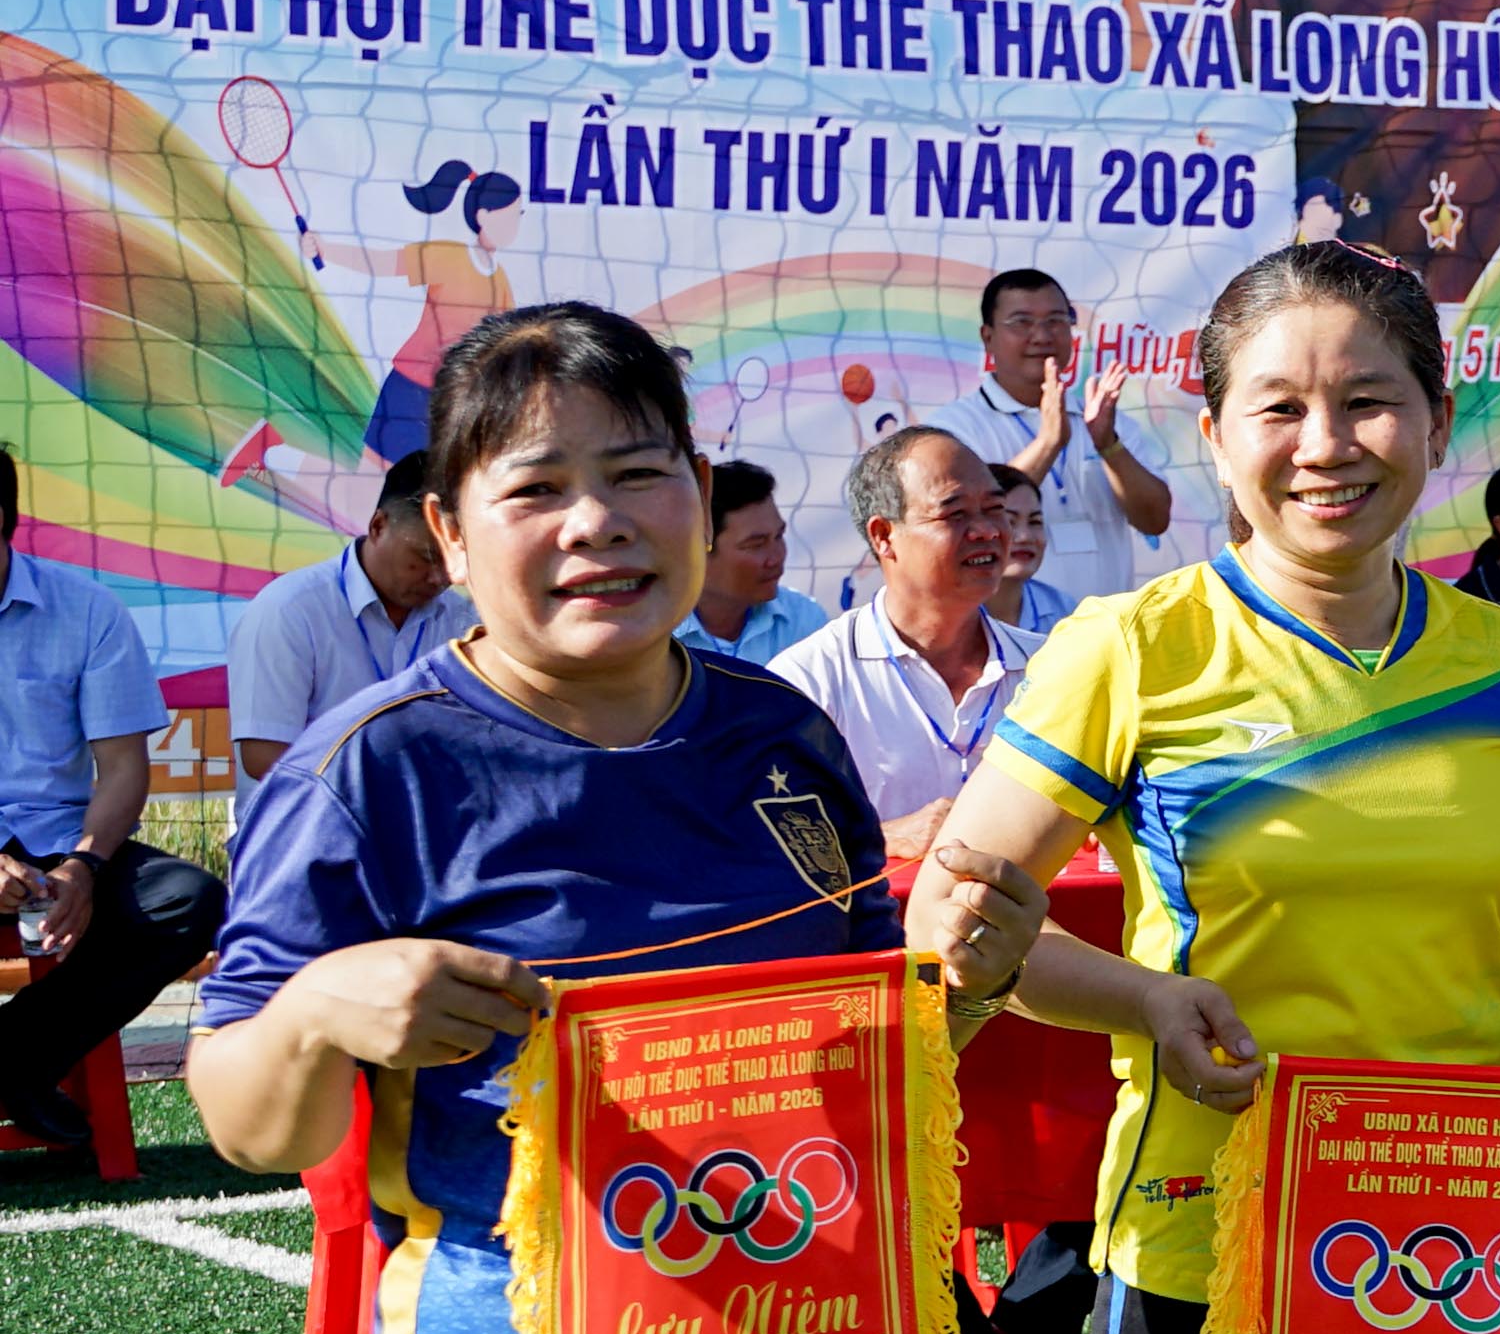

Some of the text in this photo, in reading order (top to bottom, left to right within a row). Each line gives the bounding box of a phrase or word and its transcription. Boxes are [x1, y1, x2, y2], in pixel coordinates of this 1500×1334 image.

[1257, 12, 1424, 102] LONG
[529, 93, 1255, 230] LẦN THỨ I NĂM 2026
[1463, 330, 1485, 378] 5
[643, 1018, 813, 1062] UBND XÃ LONG HỮU
[601, 1043, 855, 1108] ĐẠI HỘI THỂ DỤC THỂ THAO XÃ LONG HỮU
[628, 1105, 663, 1133] LẦN
[668, 1100, 705, 1127] THỨ
[732, 1091, 776, 1118] NĂM
[780, 1087, 823, 1111] 2026
[1364, 1112, 1412, 1132] UBND
[1416, 1112, 1439, 1132] XÃ
[1443, 1116, 1488, 1136] LONG
[1318, 1140, 1340, 1166] ĐẠI
[1344, 1137, 1365, 1166] HỘI
[1369, 1133, 1395, 1163] THỂ
[1396, 1142, 1421, 1168] DỤC
[1425, 1136, 1450, 1166] THỂ
[1452, 1146, 1482, 1168] THAO
[1348, 1168, 1382, 1193] LẦN
[1388, 1172, 1422, 1194] THỨ
[1448, 1176, 1487, 1198] NĂM
